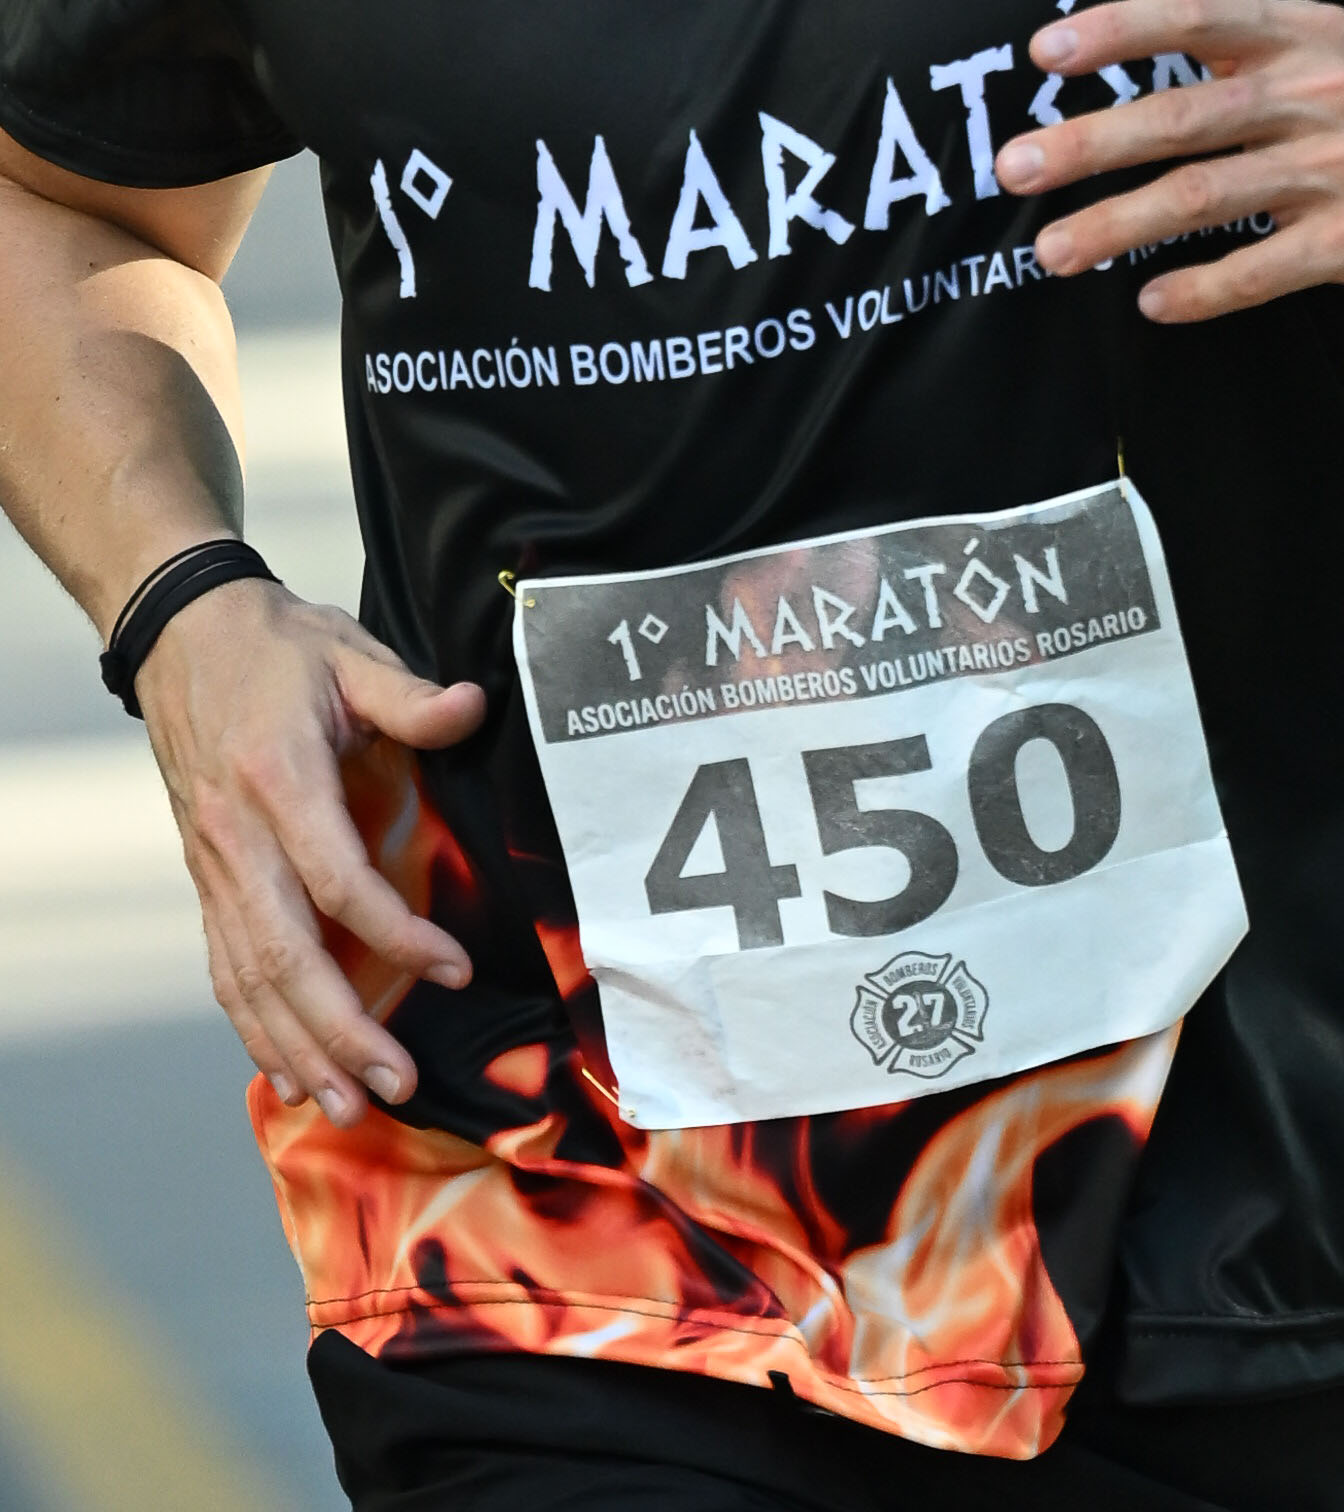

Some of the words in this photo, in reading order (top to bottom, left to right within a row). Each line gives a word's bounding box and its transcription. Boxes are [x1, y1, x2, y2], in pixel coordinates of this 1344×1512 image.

[365, 336, 560, 394] ASOCIACIÓN
[569, 308, 816, 386] BOMBEROS
[705, 537, 1069, 667] MARATÓN
[566, 685, 718, 737] ASOCIACIÓN
[720, 666, 857, 710] BOMBEROS
[859, 637, 1032, 692] VOLUNTARIOS
[1036, 606, 1148, 658] ROSARIO
[643, 701, 1123, 952] 450
[883, 962, 939, 987] BOMBEROS
[892, 992, 945, 1037] 27
[909, 1047, 952, 1068] ROSARIO
